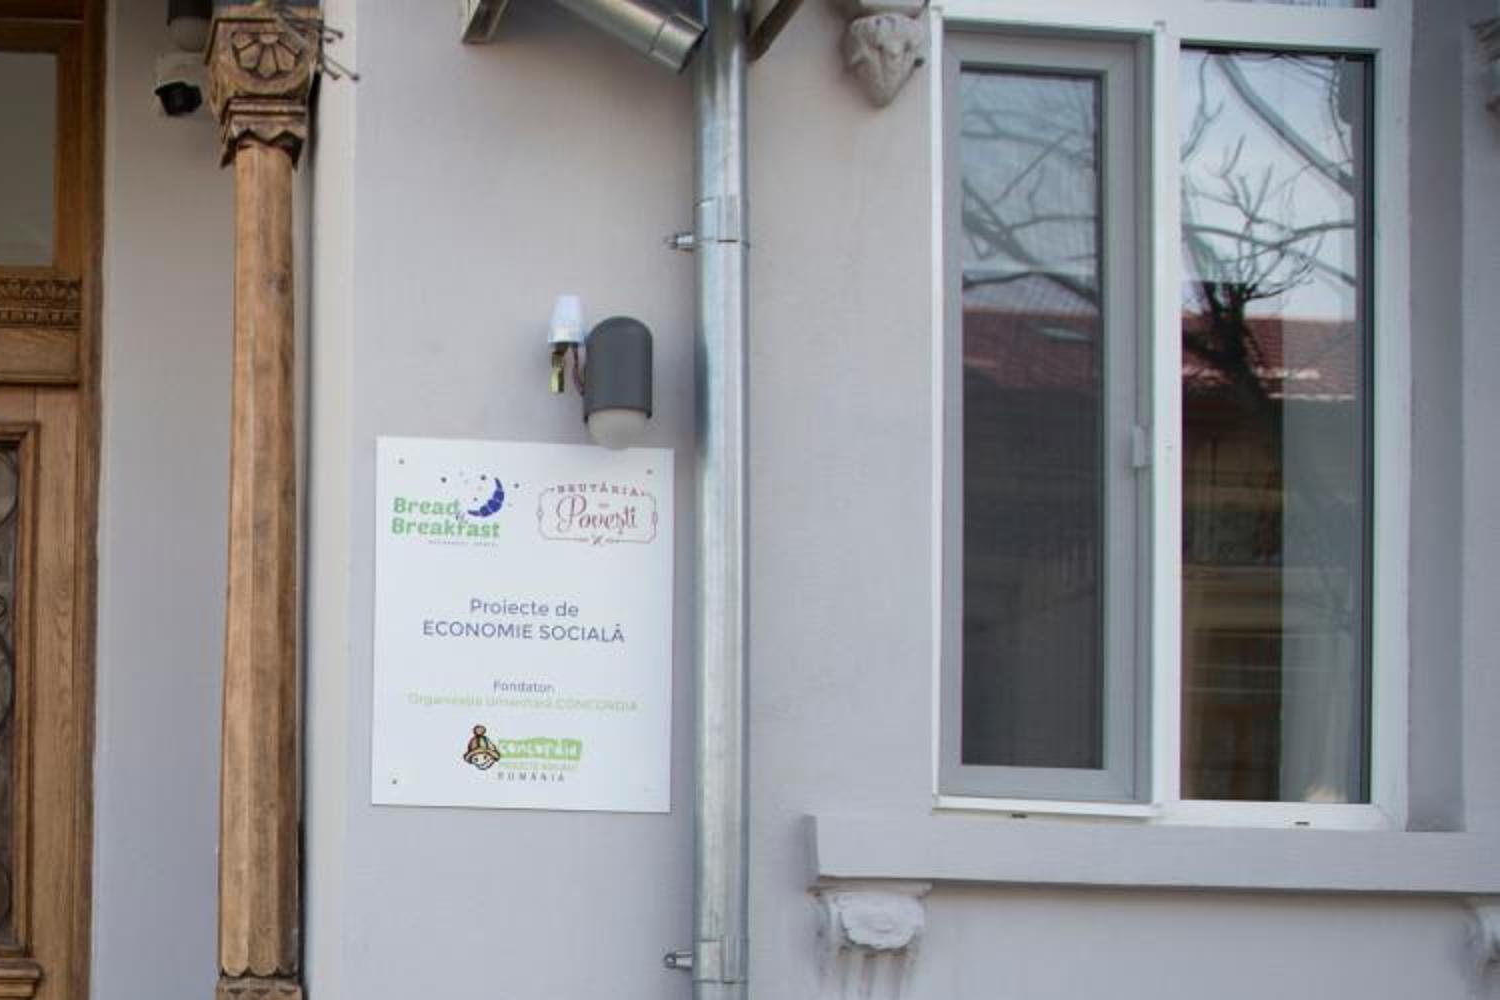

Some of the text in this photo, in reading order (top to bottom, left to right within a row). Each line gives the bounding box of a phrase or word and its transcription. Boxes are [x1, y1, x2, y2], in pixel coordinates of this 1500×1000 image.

[393, 497, 460, 516] Bread
[391, 516, 501, 538] Breakfast
[469, 598, 580, 617] Proiecte de
[423, 619, 533, 639] ECONOMIE
